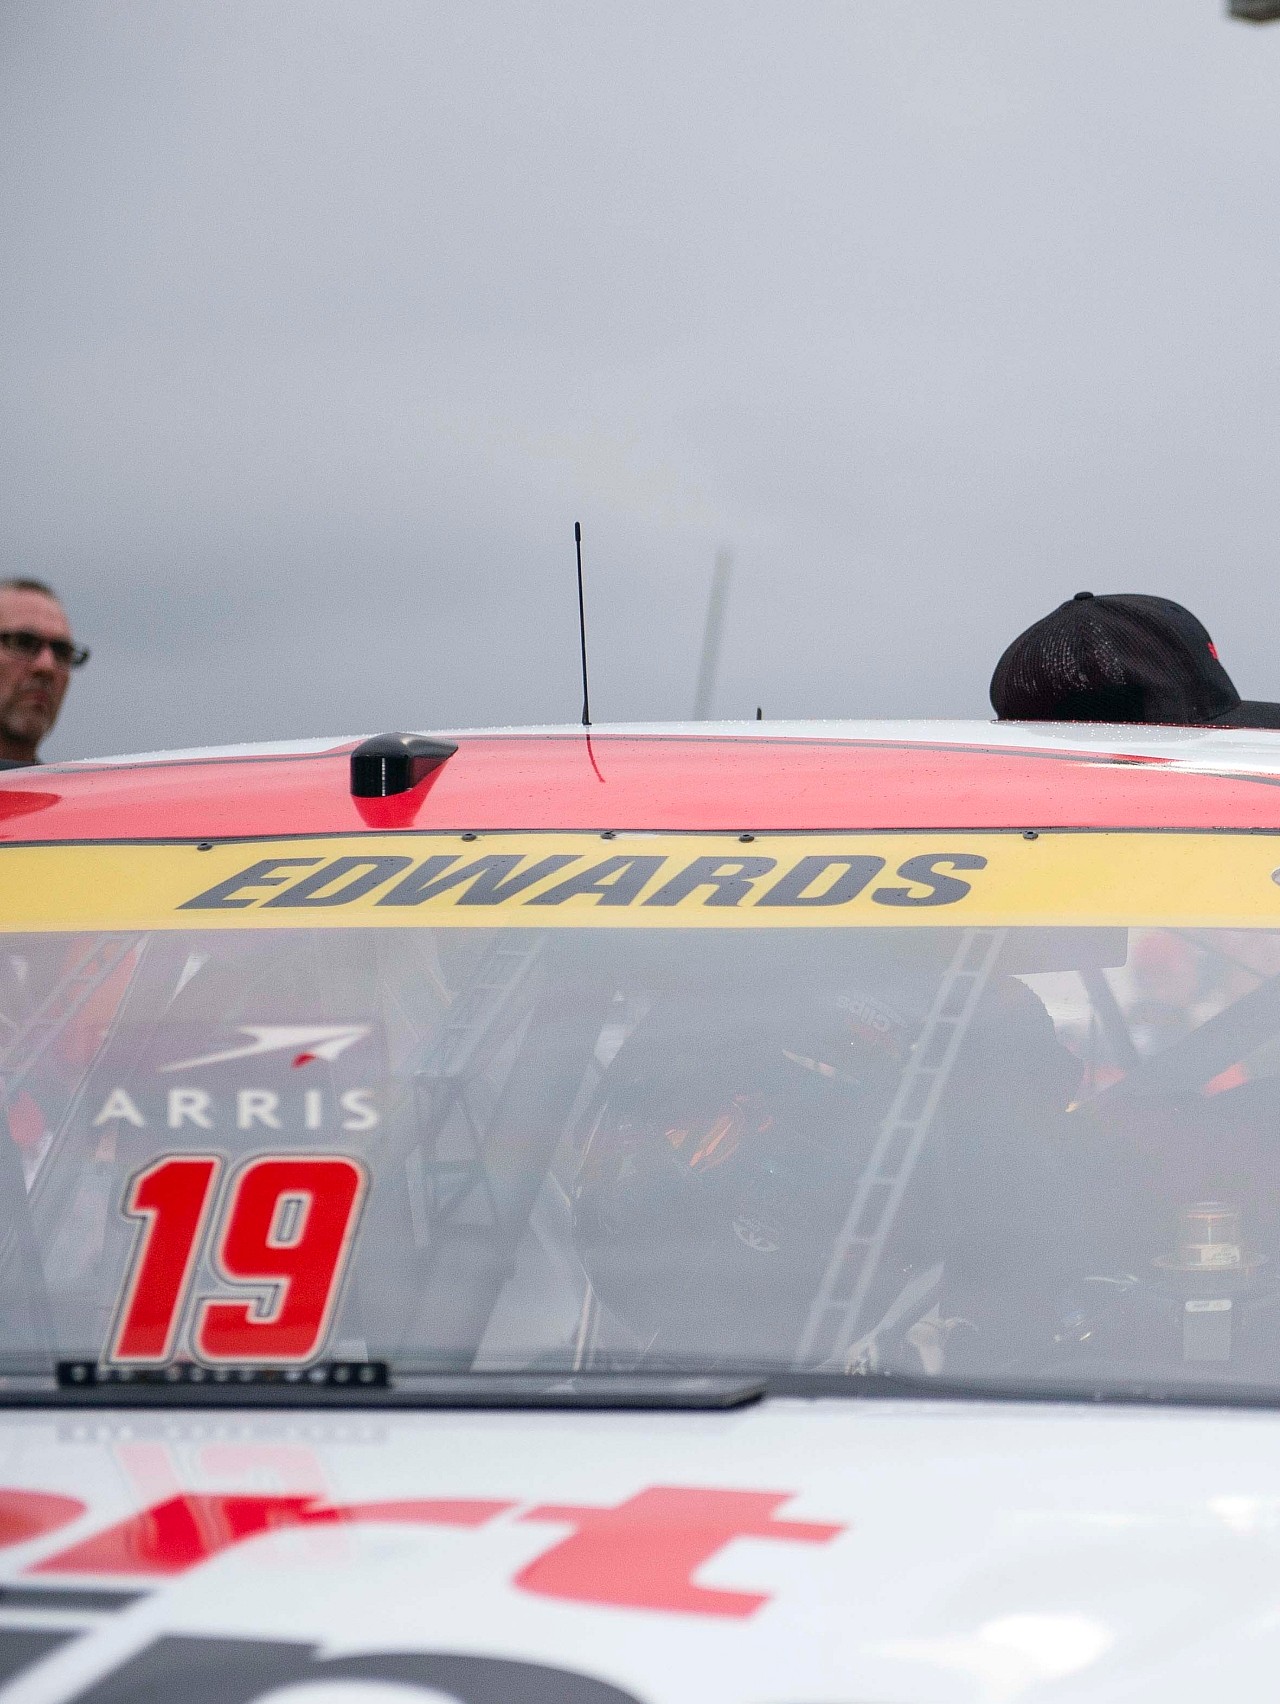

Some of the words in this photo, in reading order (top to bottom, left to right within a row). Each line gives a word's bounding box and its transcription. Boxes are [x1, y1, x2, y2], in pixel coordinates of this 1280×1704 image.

[177, 853, 989, 910] EDWARDS
[94, 1088, 381, 1131] ARRIS
[105, 1155, 371, 1367] 19
